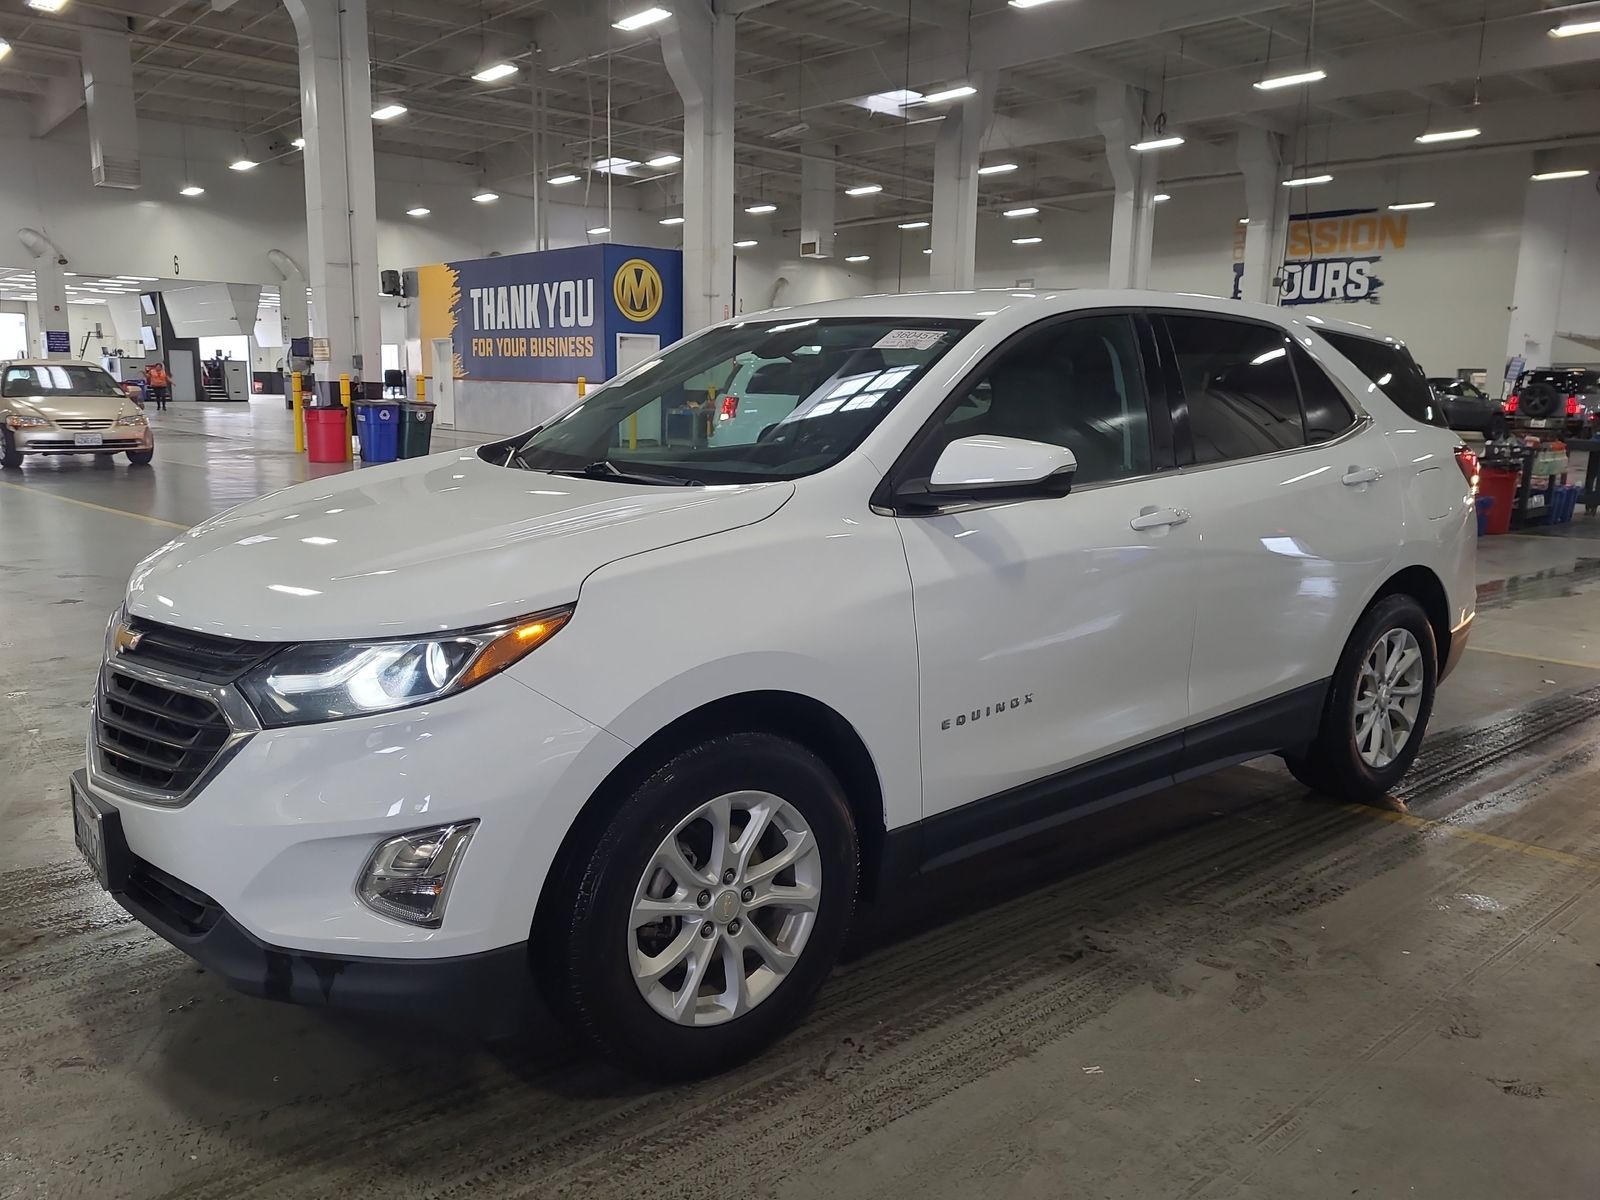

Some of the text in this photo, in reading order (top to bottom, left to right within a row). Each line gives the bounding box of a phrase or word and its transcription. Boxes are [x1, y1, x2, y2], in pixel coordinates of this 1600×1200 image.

[1287, 214, 1409, 258] SSION
[173, 254, 180, 275] 6
[1279, 261, 1371, 300] OURS
[470, 279, 594, 330] THANK YOU
[472, 336, 594, 358] FOR YOUR BUSINESS
[941, 693, 1033, 731] EQUINOX
